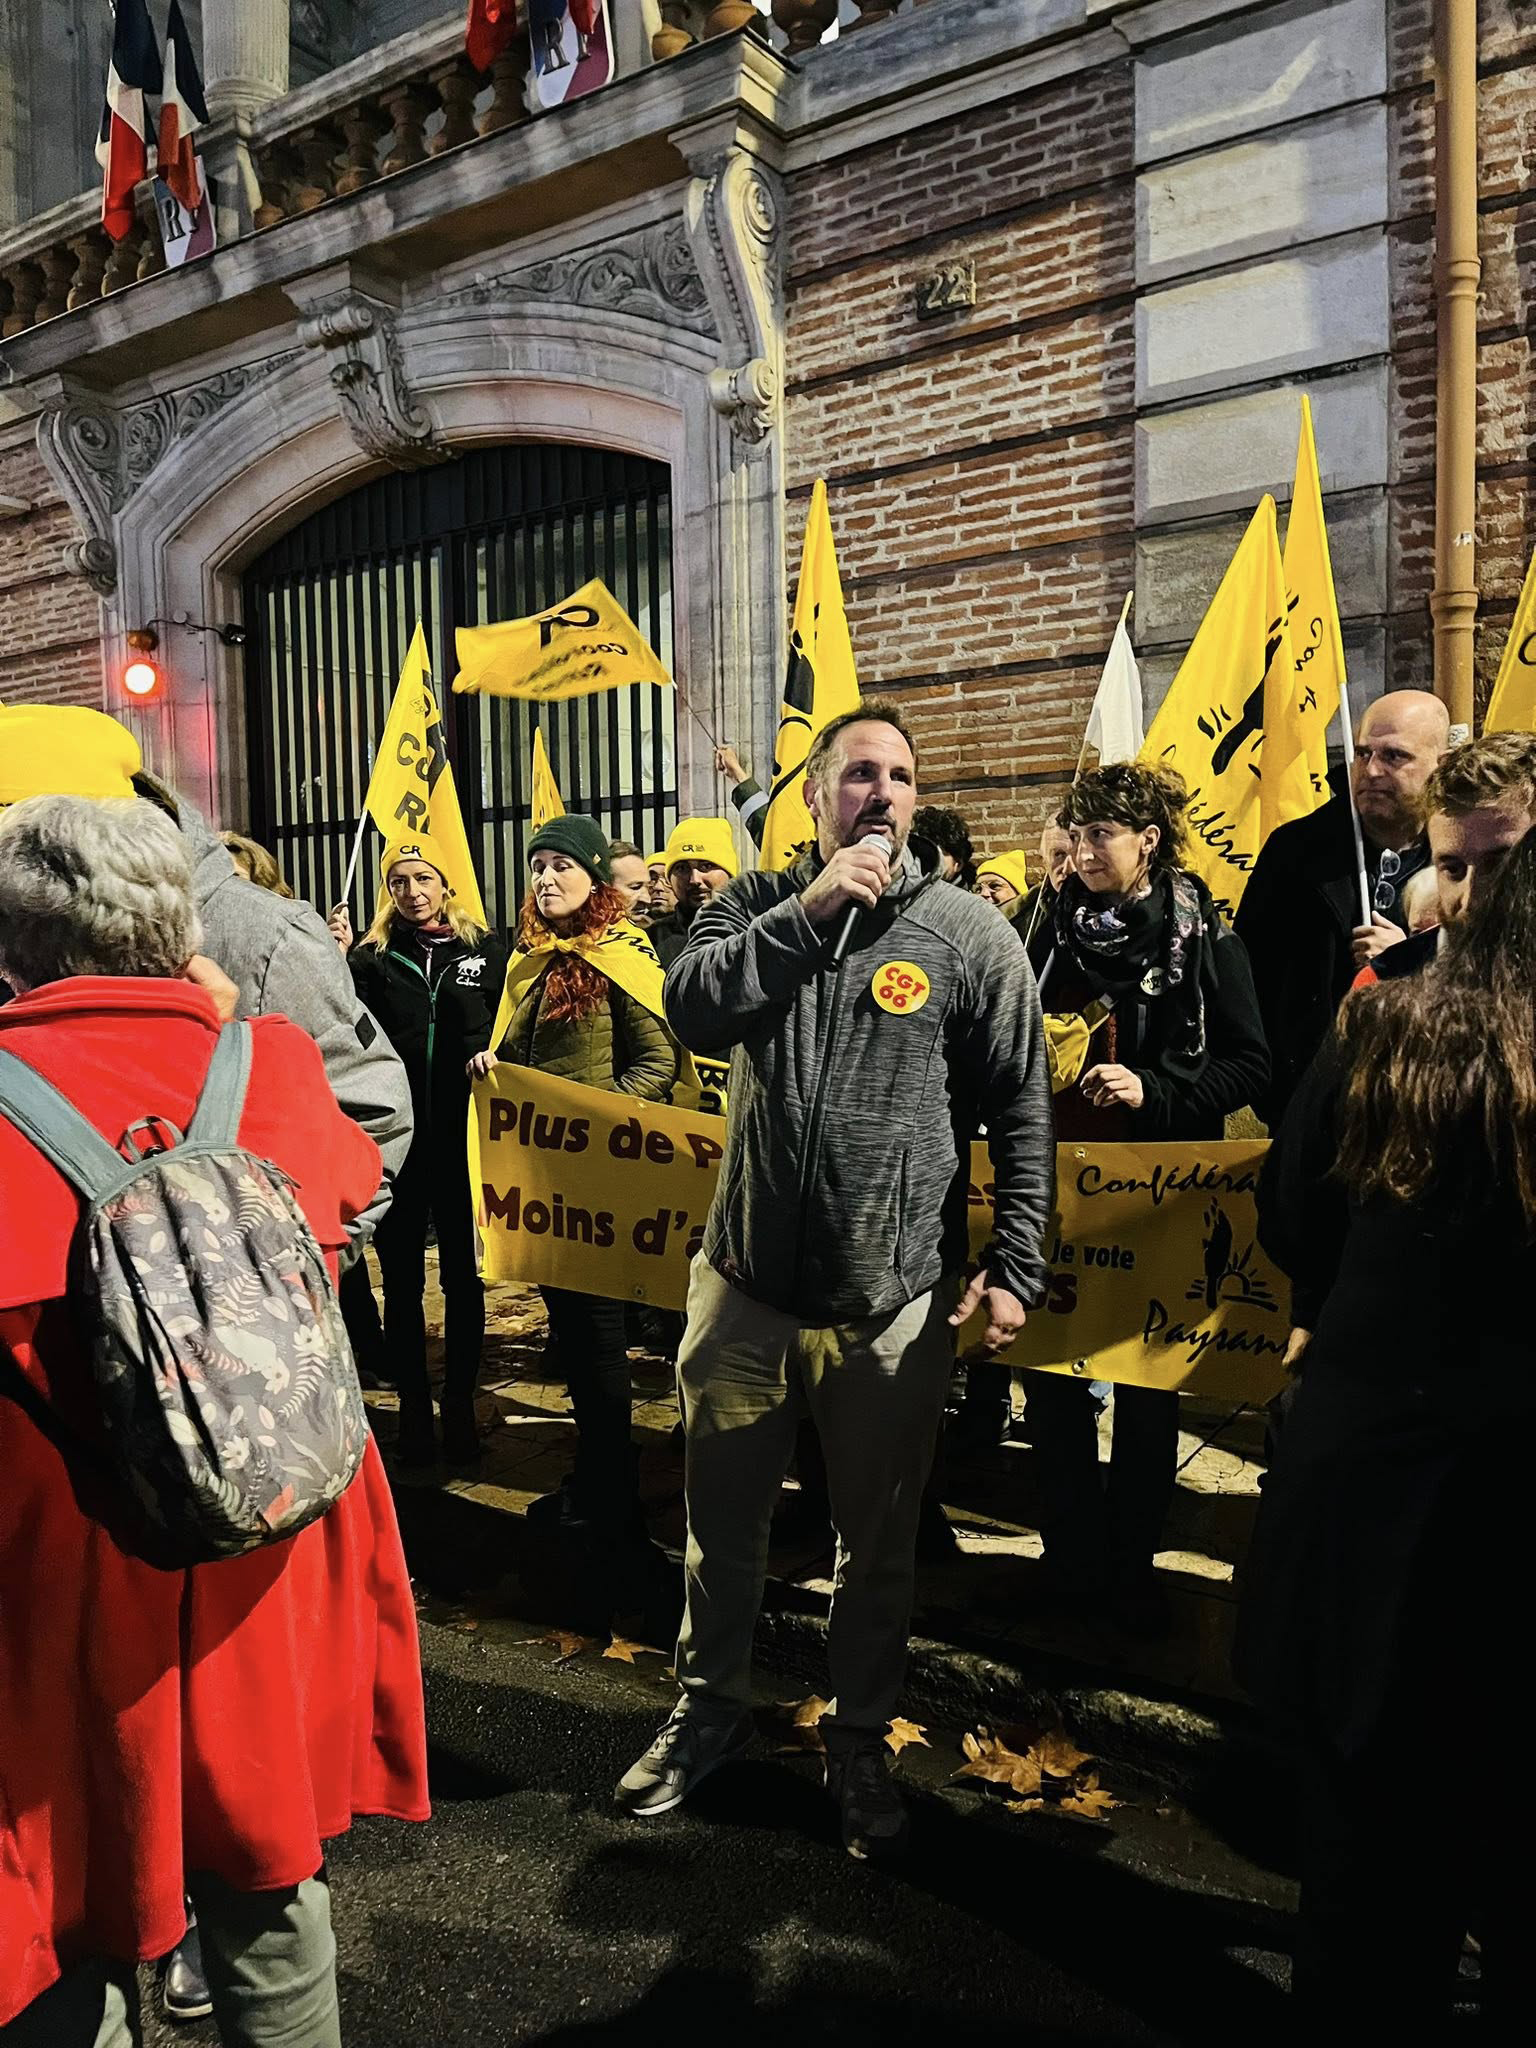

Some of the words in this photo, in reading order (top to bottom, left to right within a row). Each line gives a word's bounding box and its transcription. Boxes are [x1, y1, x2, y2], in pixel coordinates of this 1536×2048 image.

[926, 266, 966, 309] 22
[400, 845, 422, 858] CR
[885, 966, 926, 997] CGT
[489, 1097, 590, 1153] Plus
[608, 1117, 674, 1164] de
[1076, 1163, 1255, 1206] Confédéra
[479, 1183, 615, 1248] Moins
[1083, 1244, 1135, 1270] vote
